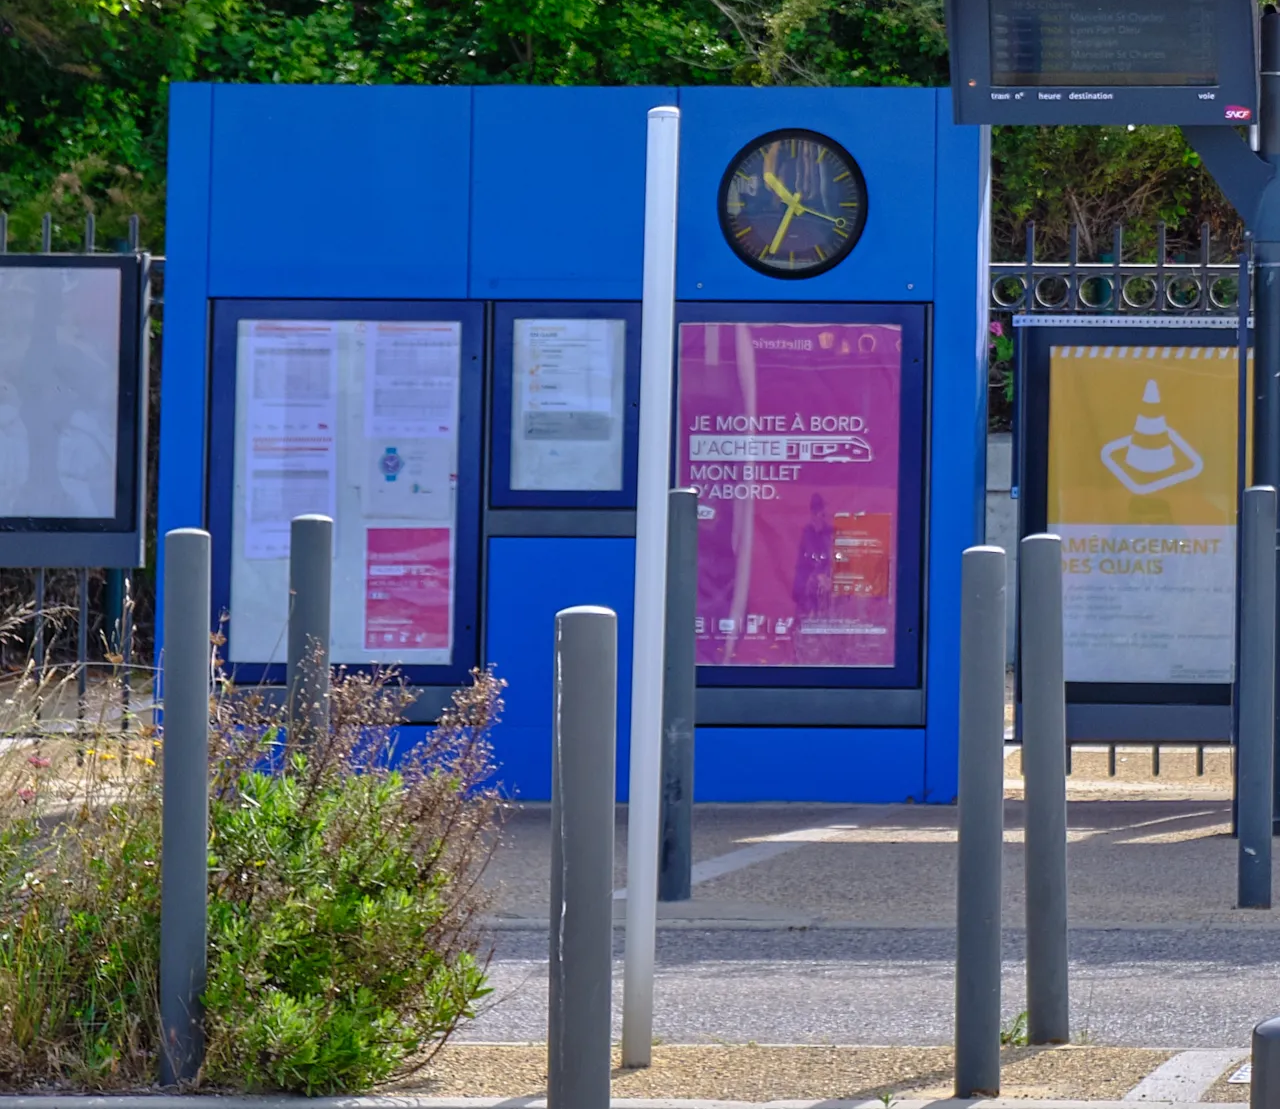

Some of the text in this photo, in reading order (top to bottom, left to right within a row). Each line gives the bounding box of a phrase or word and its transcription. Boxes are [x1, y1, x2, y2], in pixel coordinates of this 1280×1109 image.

[991, 92, 1010, 100] train
[1038, 92, 1061, 100] heure
[1068, 92, 1113, 100] destination
[1198, 92, 1215, 100] voie
[1225, 110, 1250, 119] SNCF
[690, 411, 869, 434] JE MONTE À BORD,
[691, 465, 801, 480] MON BILLET
[1099, 559, 1164, 575] QUAIS
